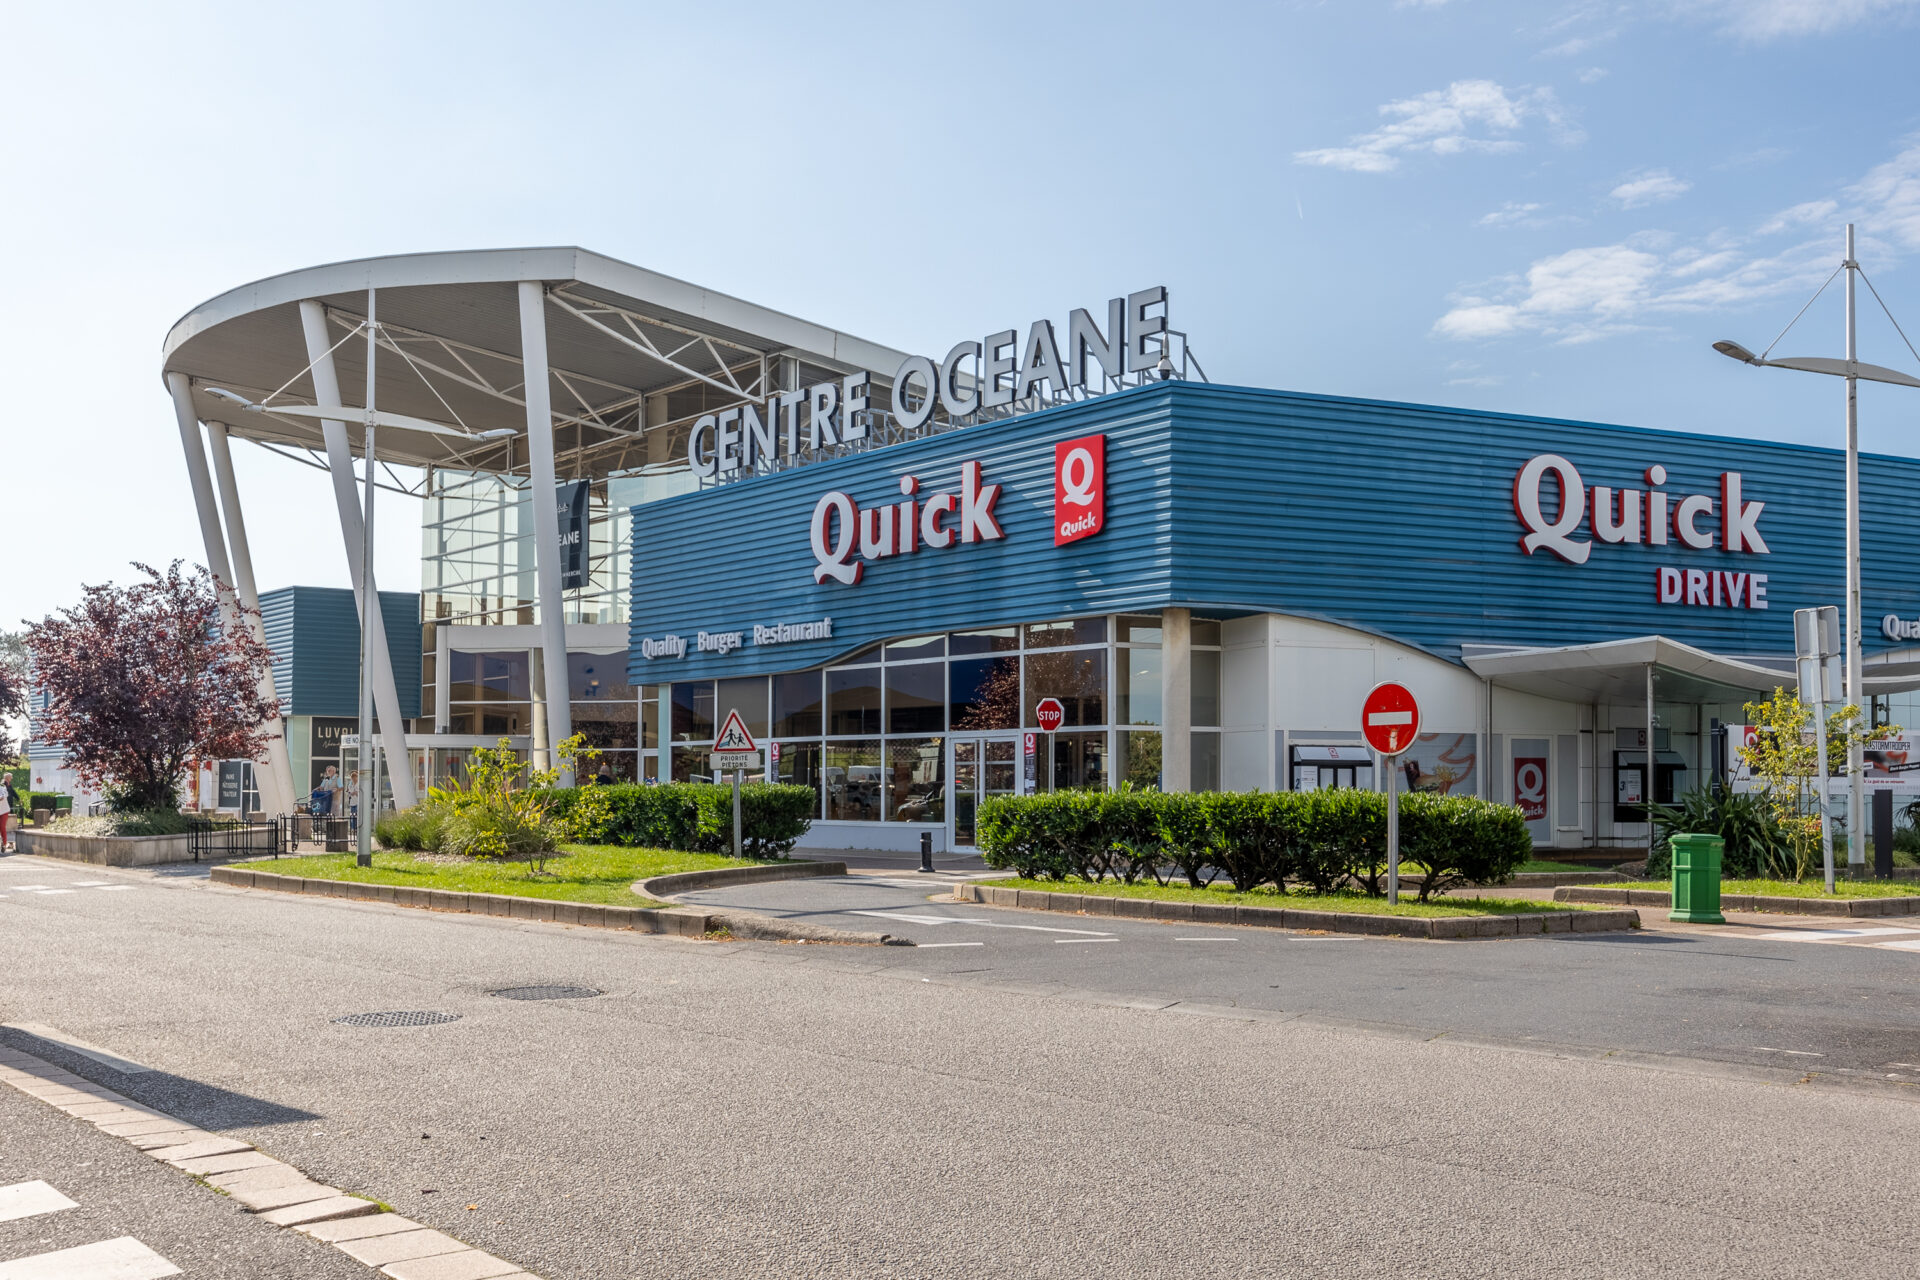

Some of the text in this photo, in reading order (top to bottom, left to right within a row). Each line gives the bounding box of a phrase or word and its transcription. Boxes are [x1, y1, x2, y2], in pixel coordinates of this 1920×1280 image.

[688, 285, 1167, 477] CENTRE OCEANE
[1061, 447, 1096, 506] Q
[811, 461, 1006, 585] Quick
[1060, 511, 1097, 537] Quick
[1513, 453, 1770, 564] Quick
[1656, 567, 1768, 609] DRIVE
[641, 616, 833, 660] Quality Burger Restaurant
[1882, 614, 1920, 641] Qua
[1039, 710, 1060, 721] STOP
[720, 754, 749, 762] PRIORITÉ
[1523, 804, 1544, 816] uick
